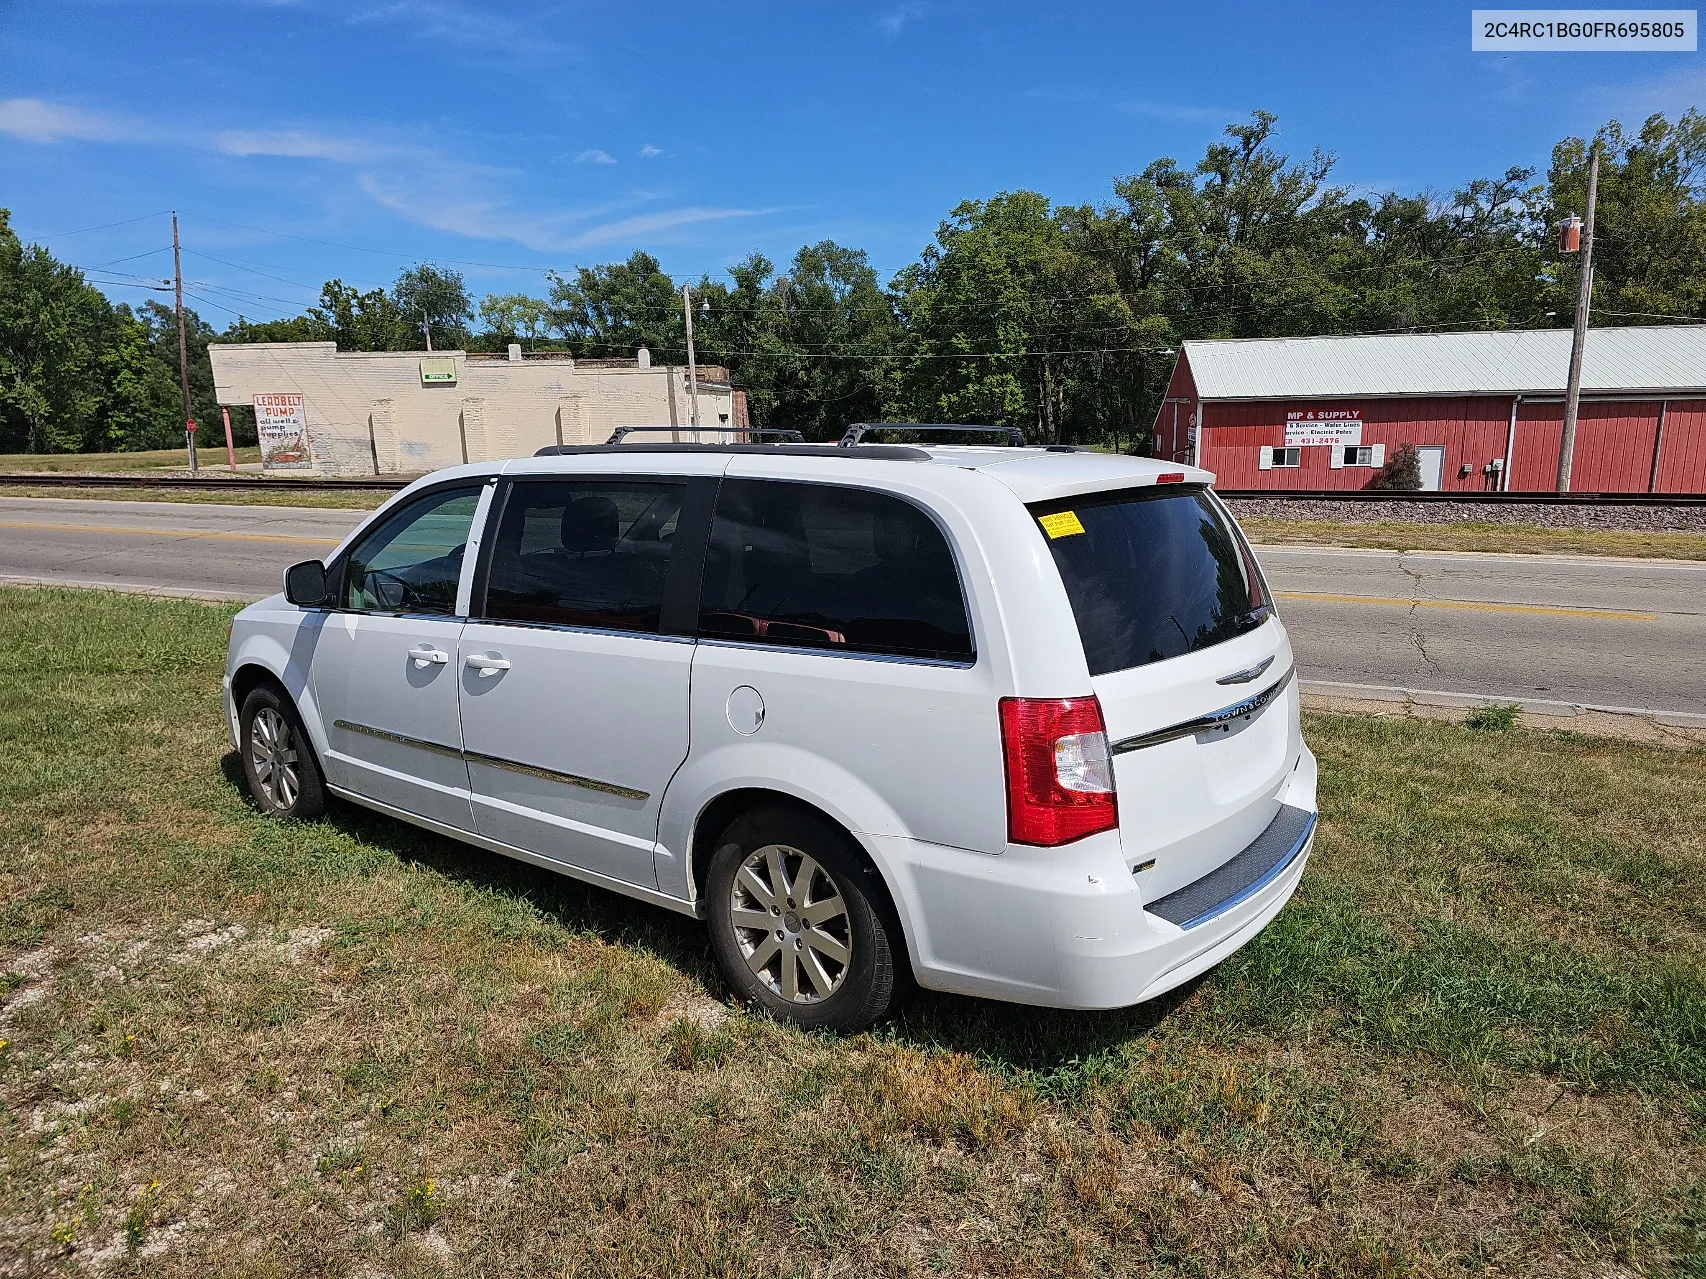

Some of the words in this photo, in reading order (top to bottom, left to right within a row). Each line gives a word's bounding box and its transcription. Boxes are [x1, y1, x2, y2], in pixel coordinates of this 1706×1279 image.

[256, 396, 302, 406] LEADBELT
[265, 407, 295, 416] PUMP
[1287, 411, 1304, 420] MP
[1306, 411, 1315, 420] &
[1317, 410, 1360, 419] SUPPLY
[260, 430, 299, 439] supplies
